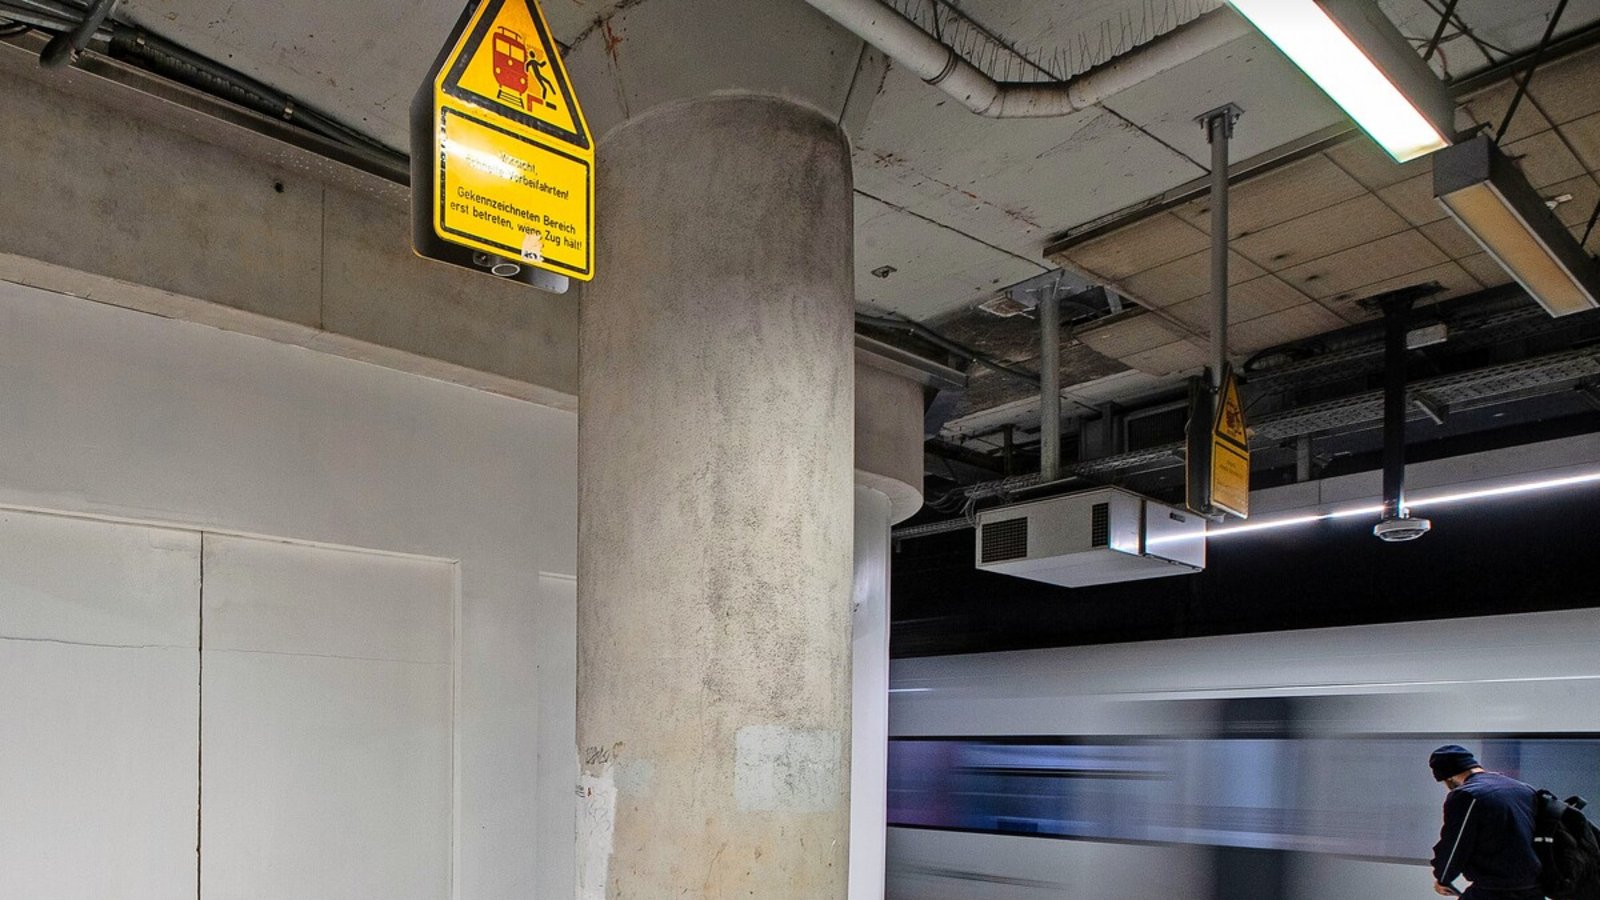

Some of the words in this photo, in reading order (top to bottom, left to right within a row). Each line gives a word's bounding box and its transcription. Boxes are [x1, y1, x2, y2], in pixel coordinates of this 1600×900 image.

[450, 202, 469, 215] erst
[473, 206, 514, 230] betreten,
[544, 230, 561, 246] Zug
[457, 186, 541, 223] Gekennzeichneten
[543, 215, 576, 234] Bereich
